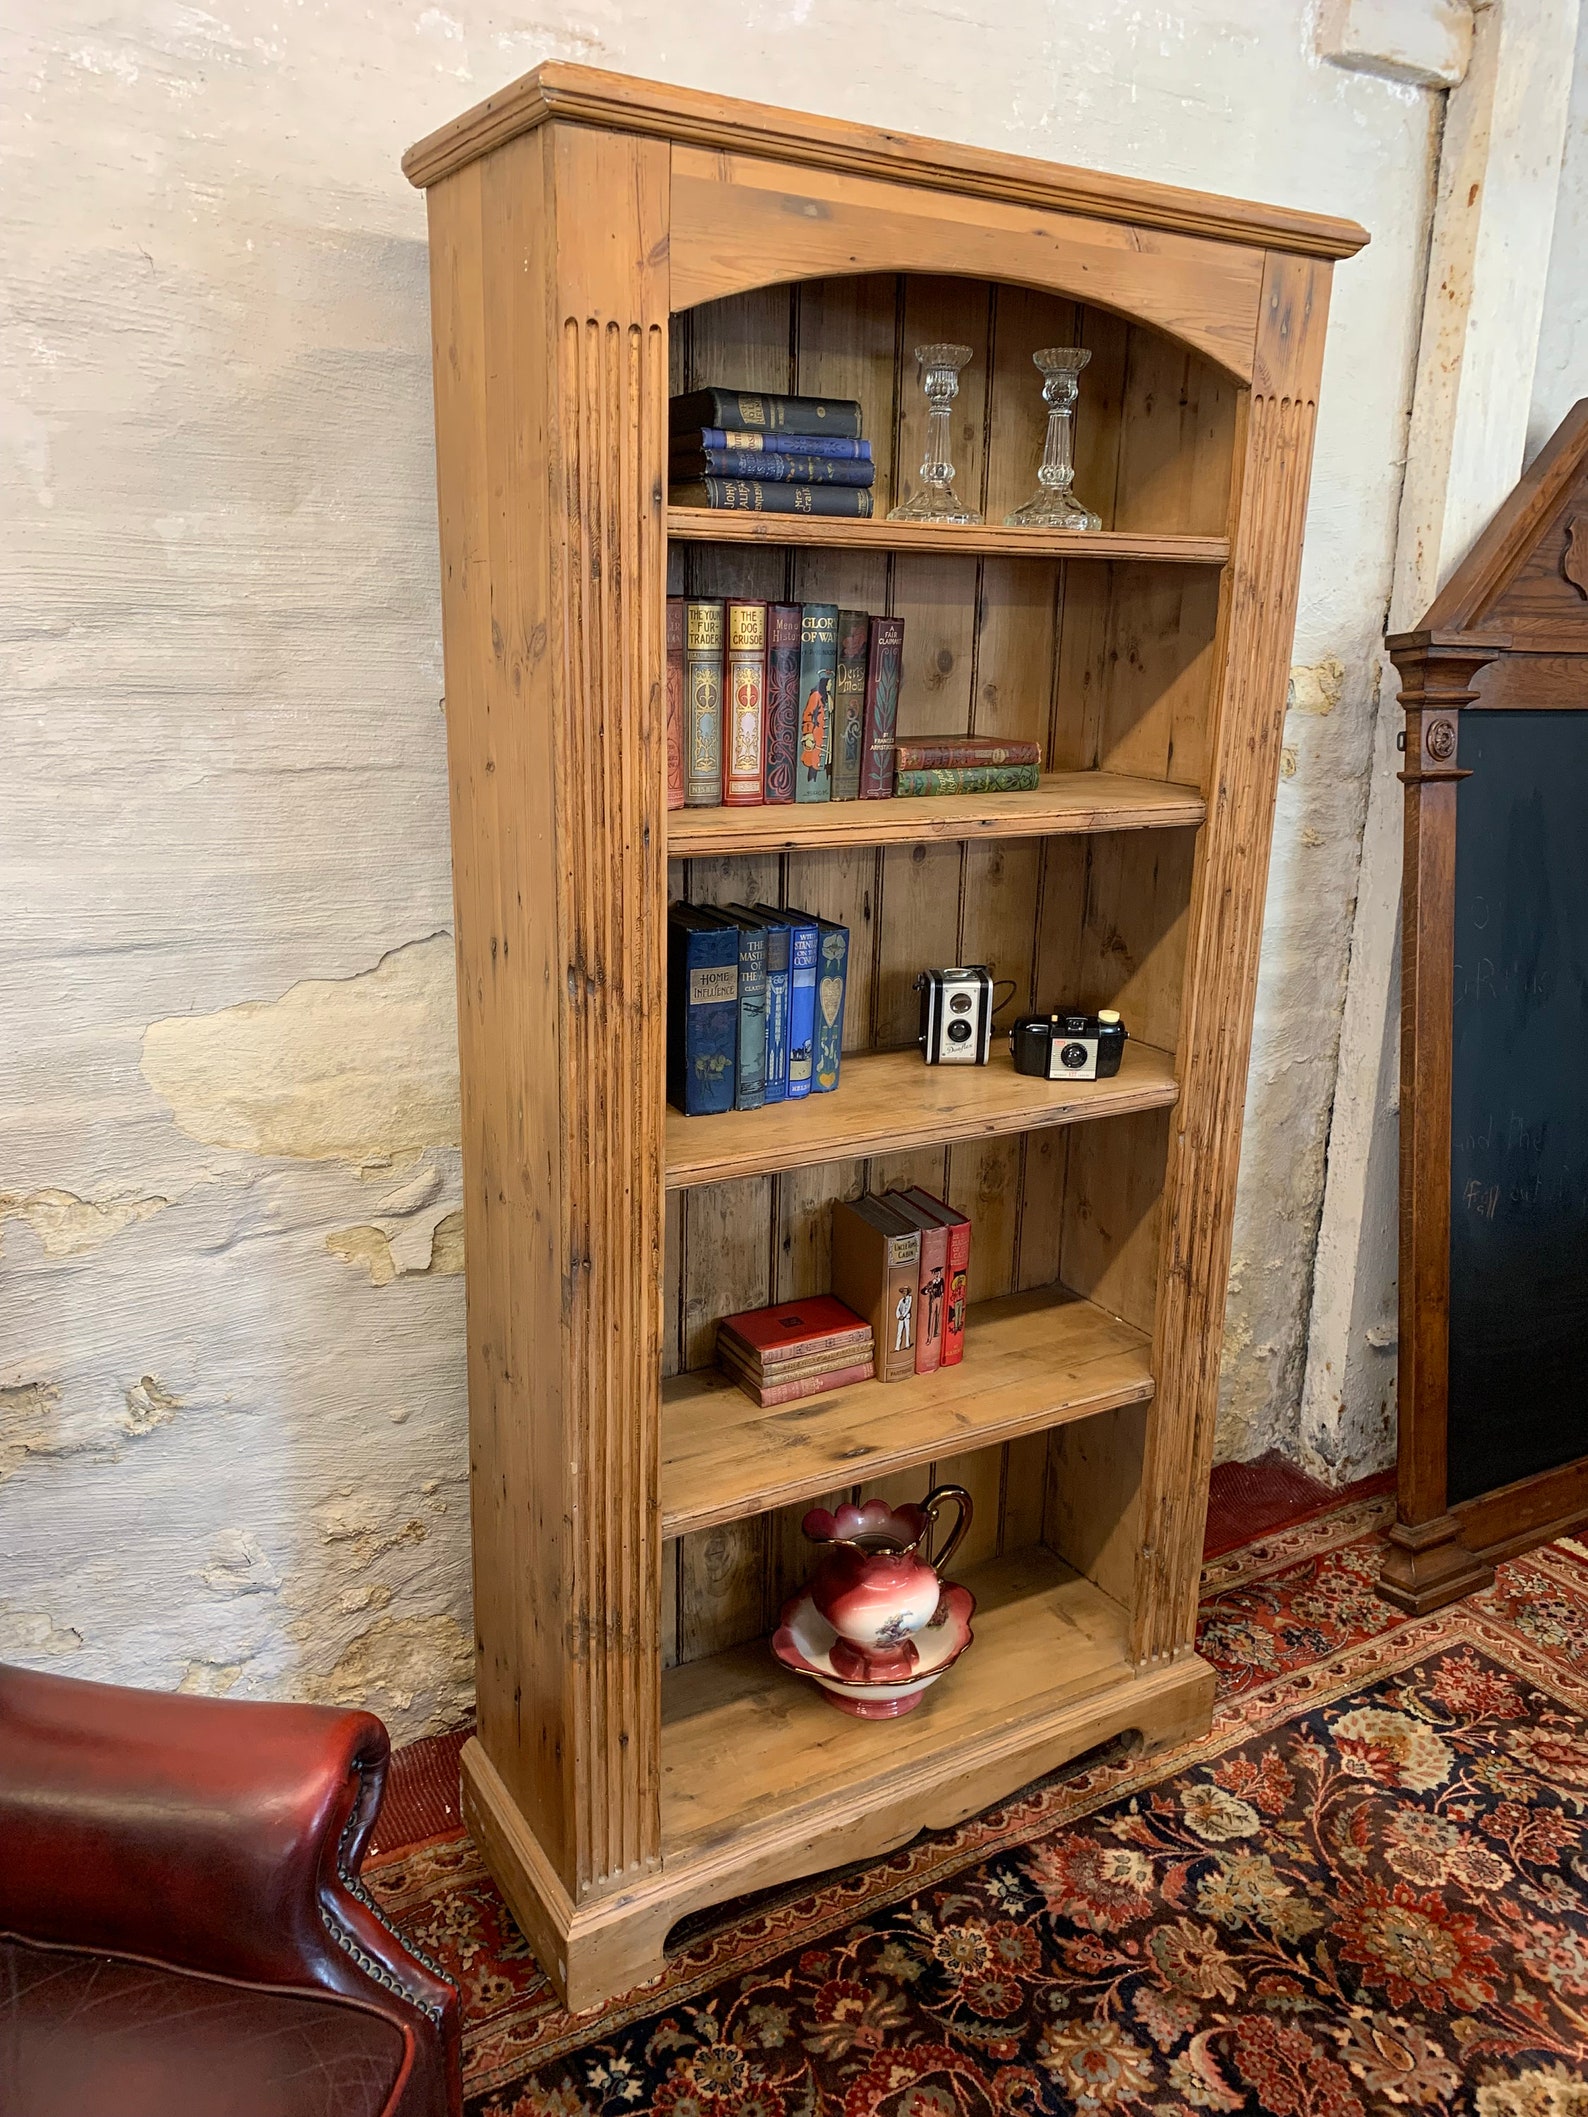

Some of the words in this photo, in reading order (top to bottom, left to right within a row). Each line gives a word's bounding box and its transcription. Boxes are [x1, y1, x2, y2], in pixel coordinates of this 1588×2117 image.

[724, 481, 739, 509] JOHN
[753, 480, 764, 512] ENTLEMAN
[803, 487, 812, 513] Craik
[689, 610, 704, 621] THE
[741, 611, 757, 622] THE
[697, 622, 719, 633] FUR-
[741, 623, 758, 633] DOG
[776, 619, 793, 630] Men
[733, 635, 763, 645] CRUSOE
[801, 632, 817, 643] OF
[747, 940, 764, 951] THE
[739, 951, 766, 962] MASTE
[750, 962, 761, 971] OF
[700, 972, 729, 985] HOME
[741, 972, 757, 982] THE
[694, 984, 735, 998] INFLUENCE
[894, 1242, 908, 1252] UNCLE
[898, 1250, 914, 1259] CABIN
